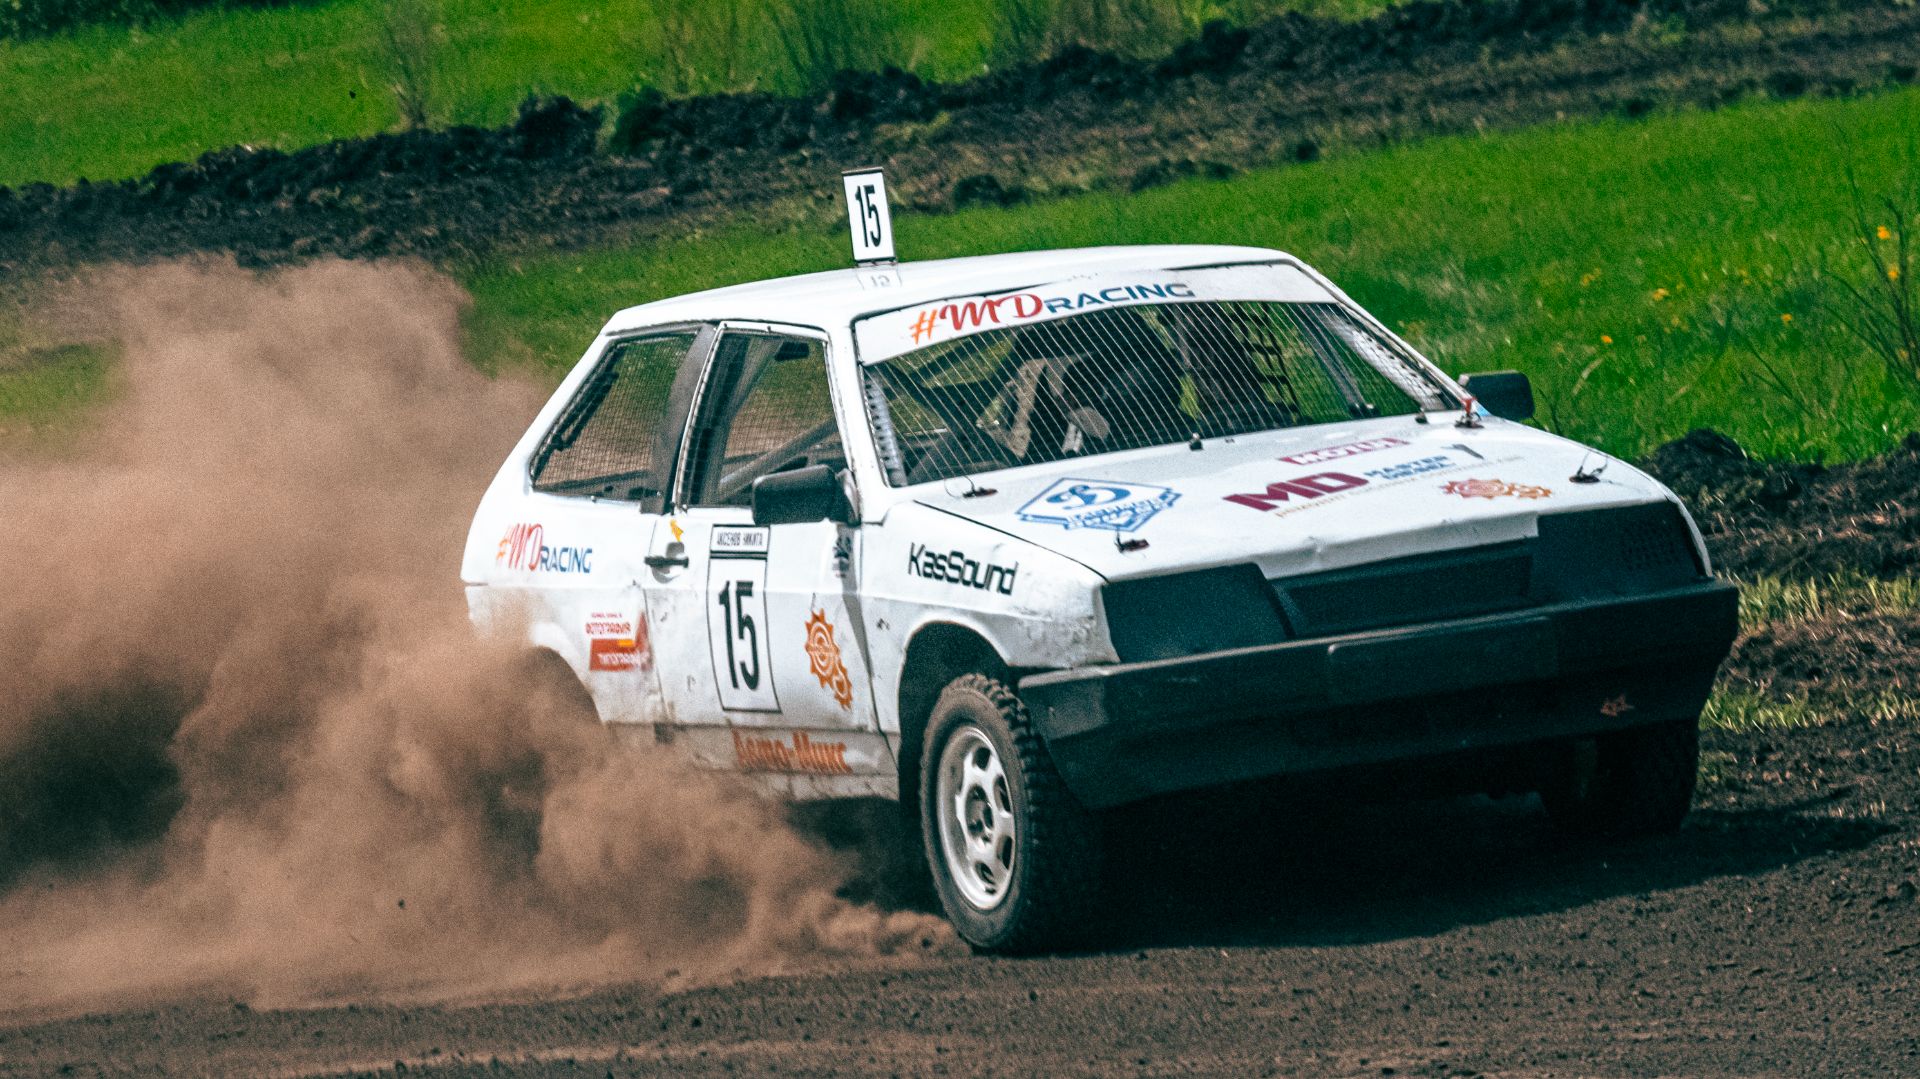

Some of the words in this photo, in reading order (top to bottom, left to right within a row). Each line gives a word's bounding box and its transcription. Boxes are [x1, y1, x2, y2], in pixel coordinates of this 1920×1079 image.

[855, 184, 881, 248] 15
[1222, 471, 1369, 511] MD
[907, 542, 1019, 595] KasSound
[719, 580, 759, 690] 15
